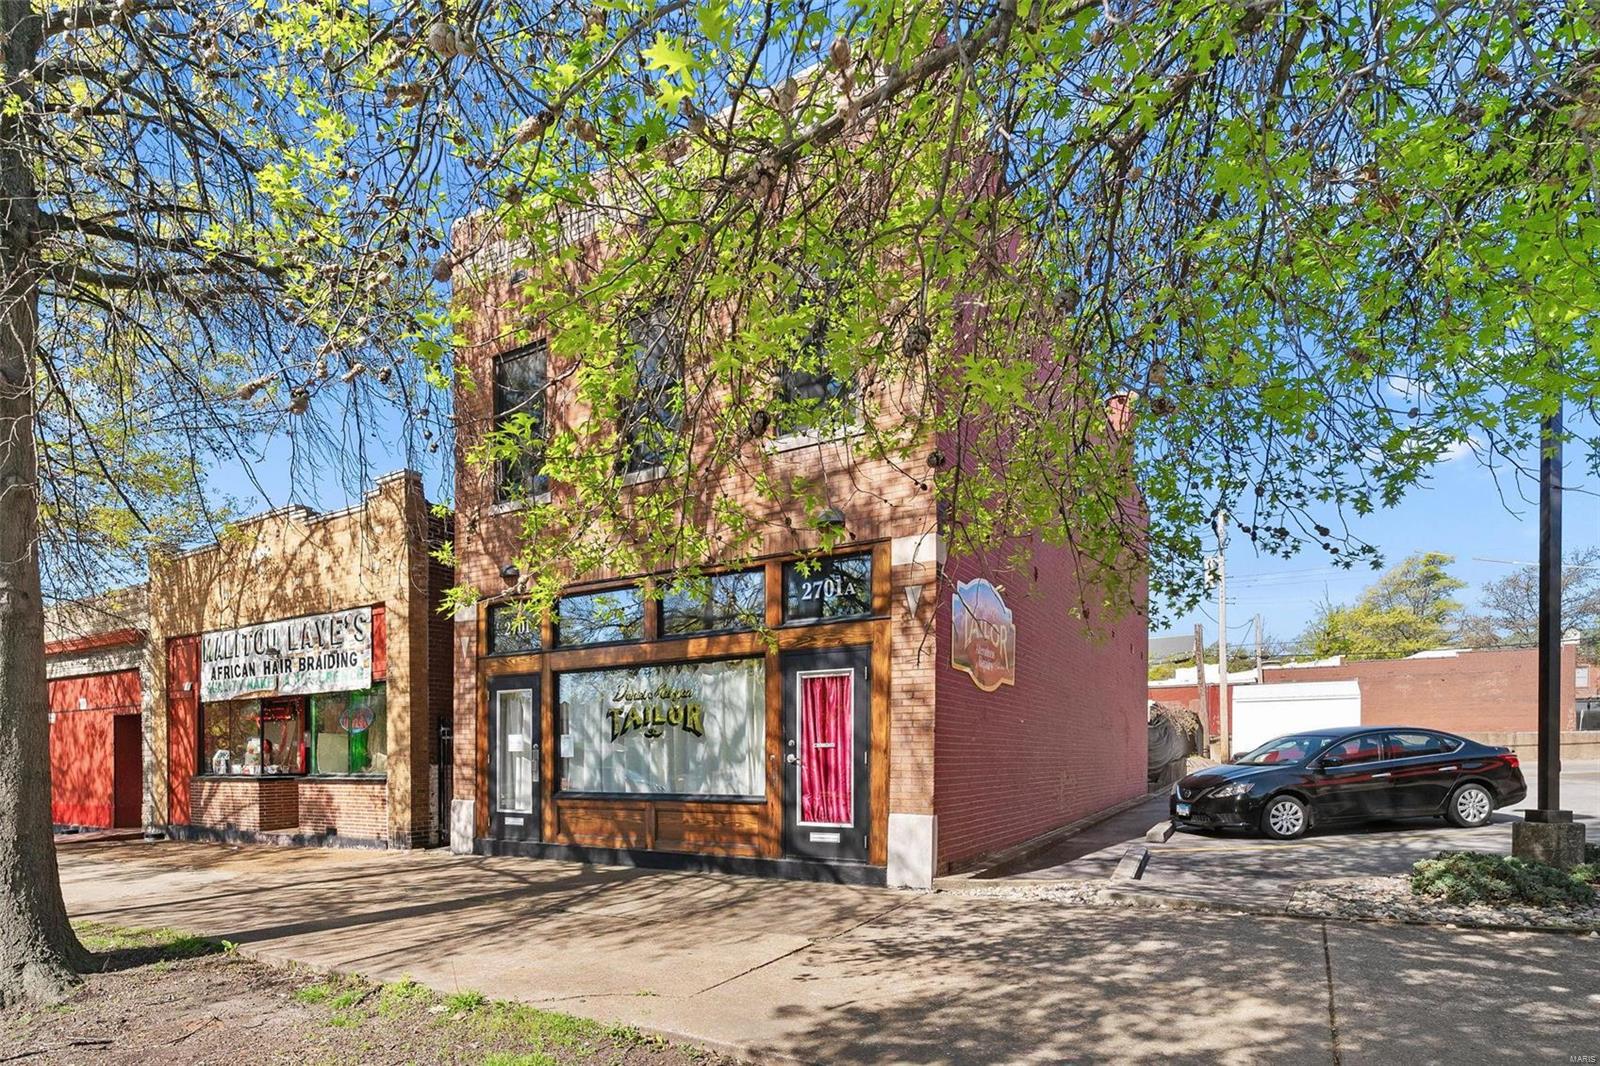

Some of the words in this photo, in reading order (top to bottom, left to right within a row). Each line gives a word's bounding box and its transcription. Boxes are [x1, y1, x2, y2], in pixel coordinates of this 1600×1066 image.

[287, 612, 367, 651] LAYE'S
[210, 661, 256, 681] AFRICAN
[263, 658, 292, 675] HAIR
[298, 651, 358, 671] BRAIDING
[606, 703, 705, 743] TAILOR
